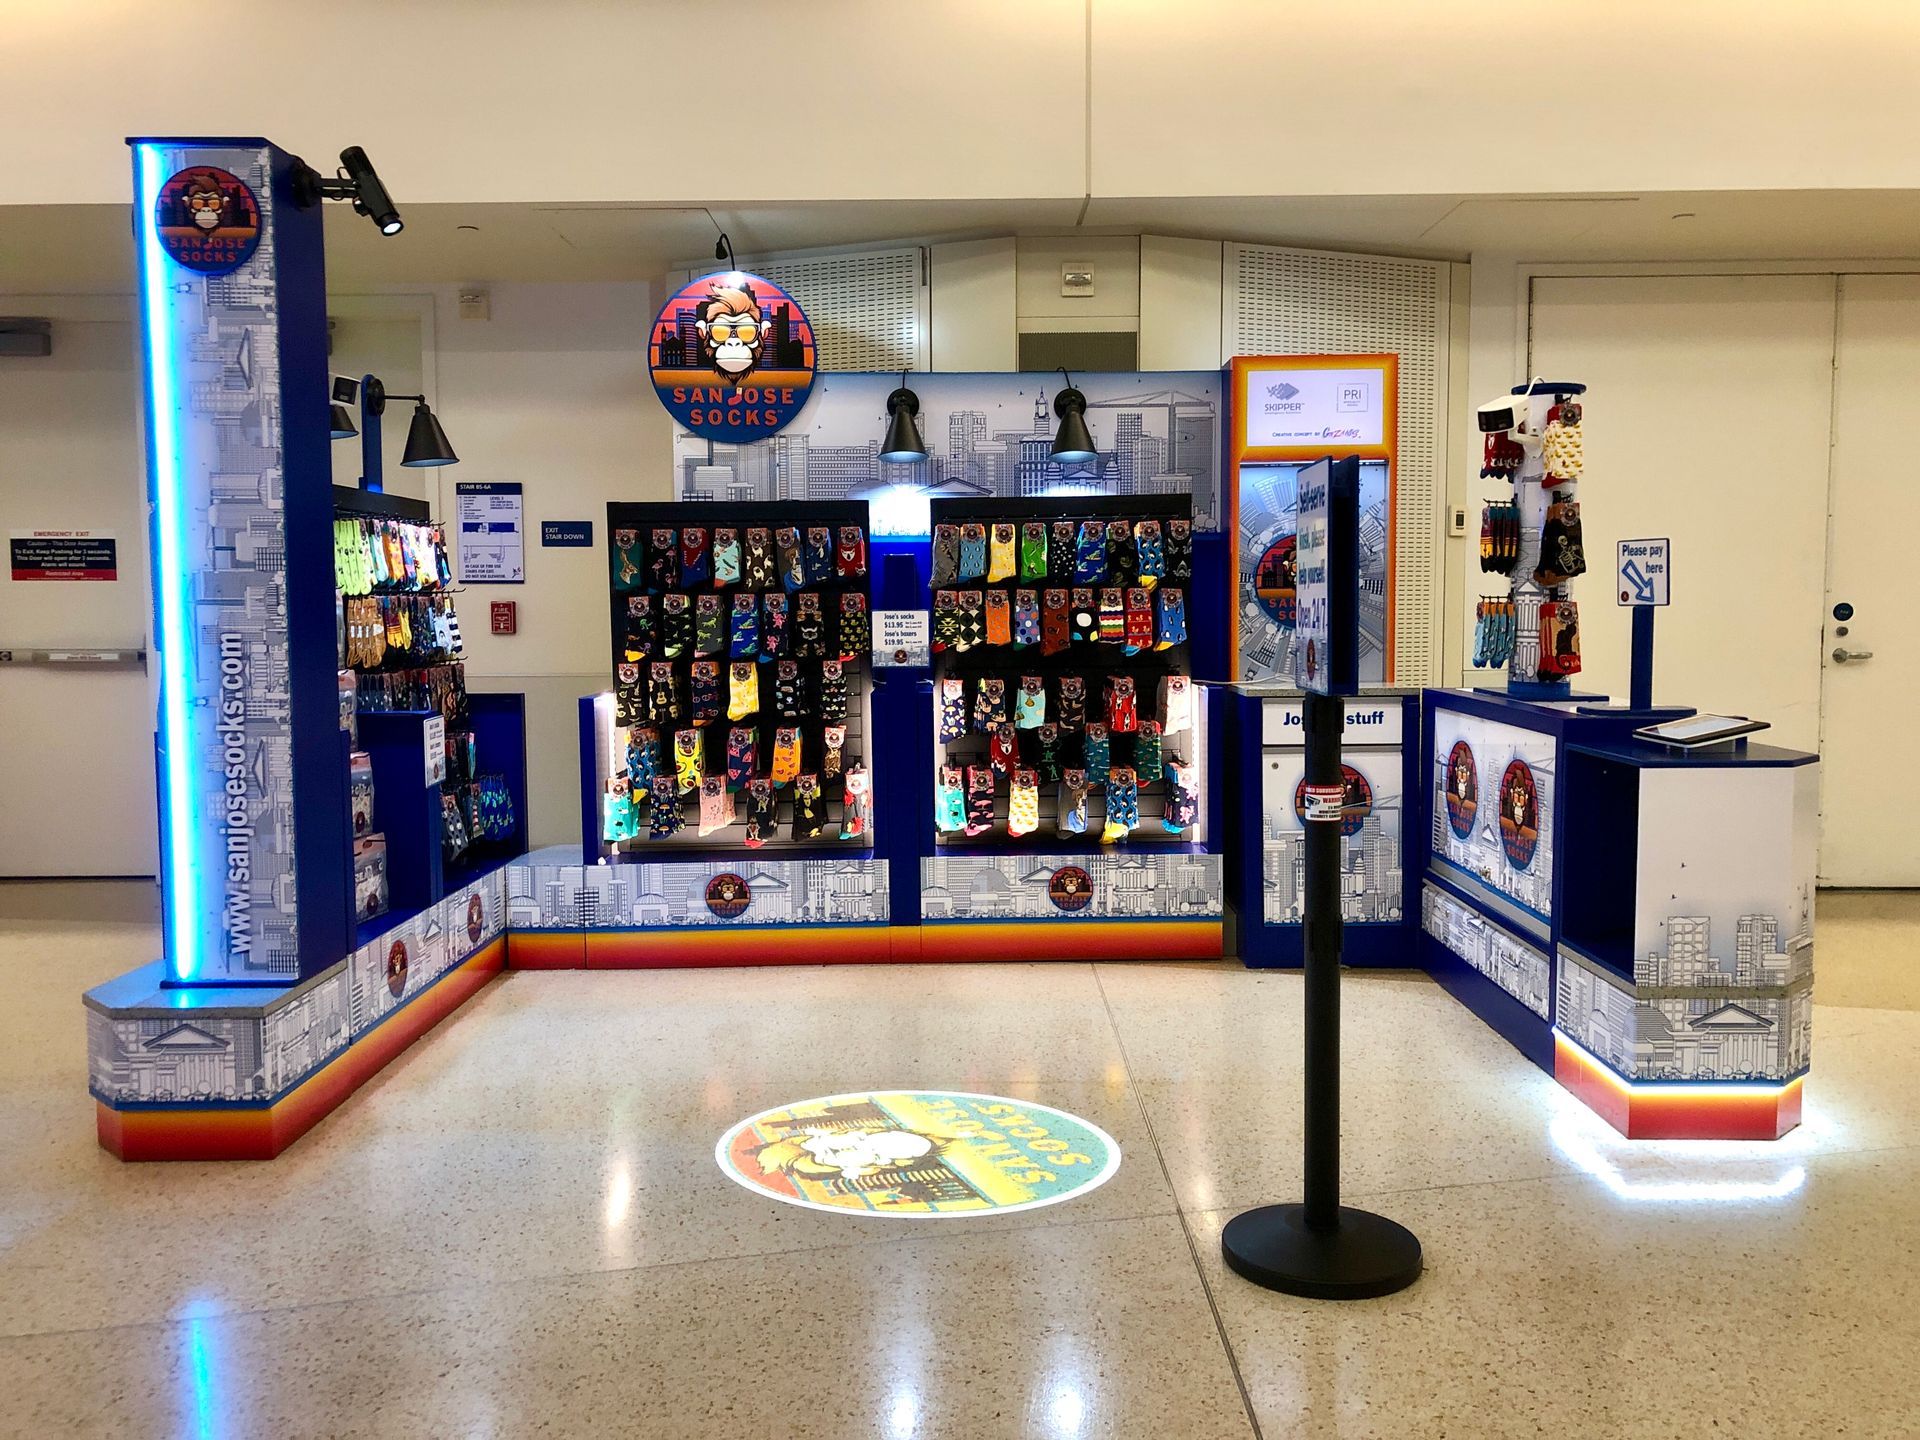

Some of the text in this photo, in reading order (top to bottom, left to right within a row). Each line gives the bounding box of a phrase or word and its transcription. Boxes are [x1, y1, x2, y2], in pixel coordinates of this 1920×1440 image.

[169, 238, 246, 250] SAN JOSE
[180, 252, 236, 262] SOCKS
[674, 386, 794, 406] SAN JOSE
[1344, 390, 1362, 400] PRI
[1264, 402, 1302, 412] SKIPPER
[690, 408, 778, 426] SOCKS
[1622, 544, 1663, 557] Please pay
[1646, 562, 1663, 573] here
[1269, 599, 1296, 608] SAN
[1298, 598, 1310, 634] Open
[1346, 711, 1384, 724] stuff
[216, 632, 256, 954] www.sanjosesocks.com
[1507, 844, 1529, 863] SOCKS
[969, 1102, 1092, 1166] SOCKS
